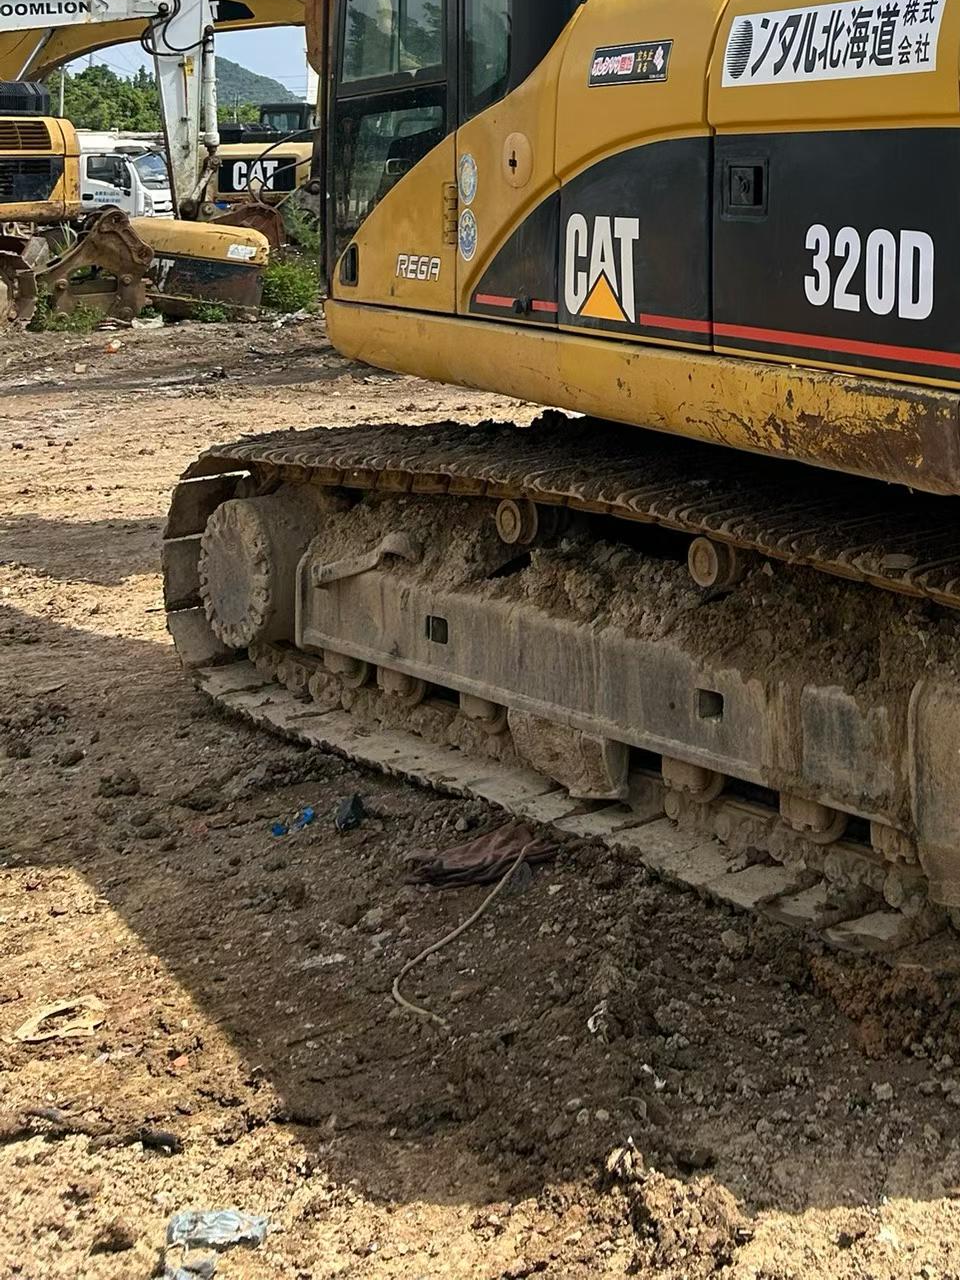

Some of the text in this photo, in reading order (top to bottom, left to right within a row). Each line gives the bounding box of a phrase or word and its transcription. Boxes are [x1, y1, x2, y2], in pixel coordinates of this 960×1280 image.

[897, 32, 930, 65] 会社
[232, 160, 279, 191] CAT
[395, 253, 441, 282] REGA
[564, 213, 640, 324] CAT
[804, 223, 935, 320] 320D
